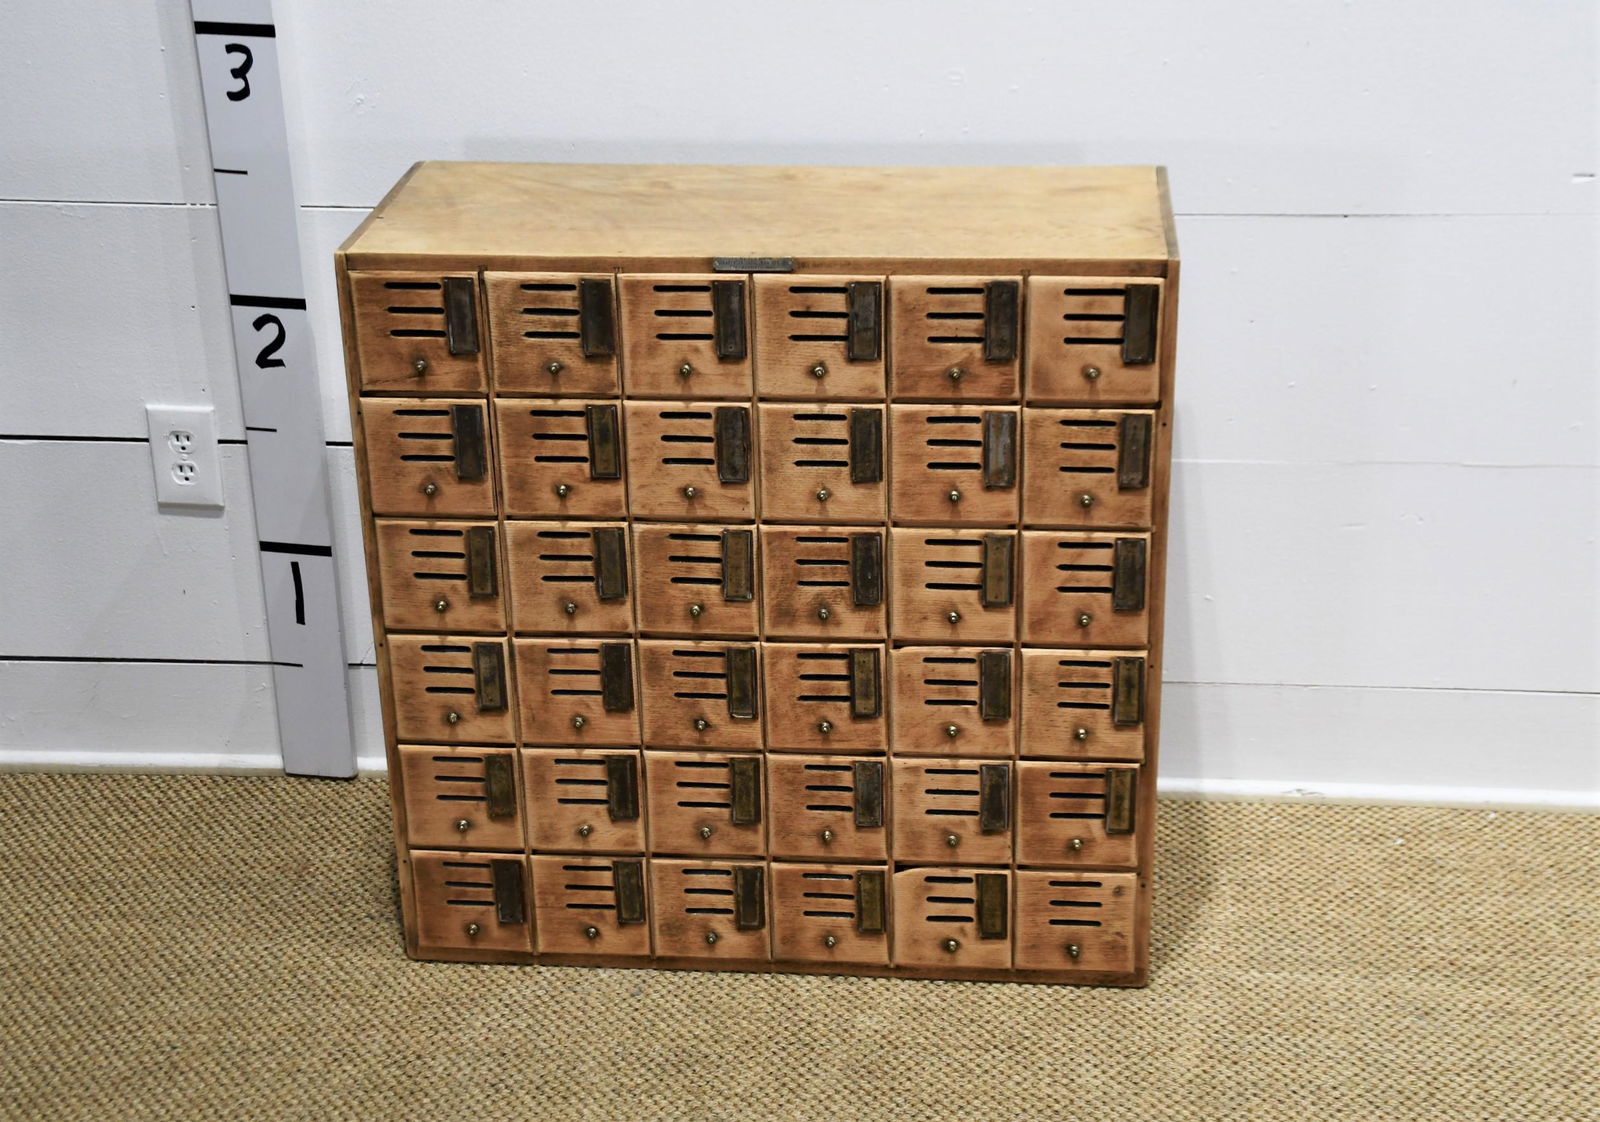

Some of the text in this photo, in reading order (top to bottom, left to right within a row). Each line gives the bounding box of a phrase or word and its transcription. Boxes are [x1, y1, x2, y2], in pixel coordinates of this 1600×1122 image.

[225, 43, 253, 101] 3
[252, 313, 286, 369] 2
[290, 561, 306, 625] 1
